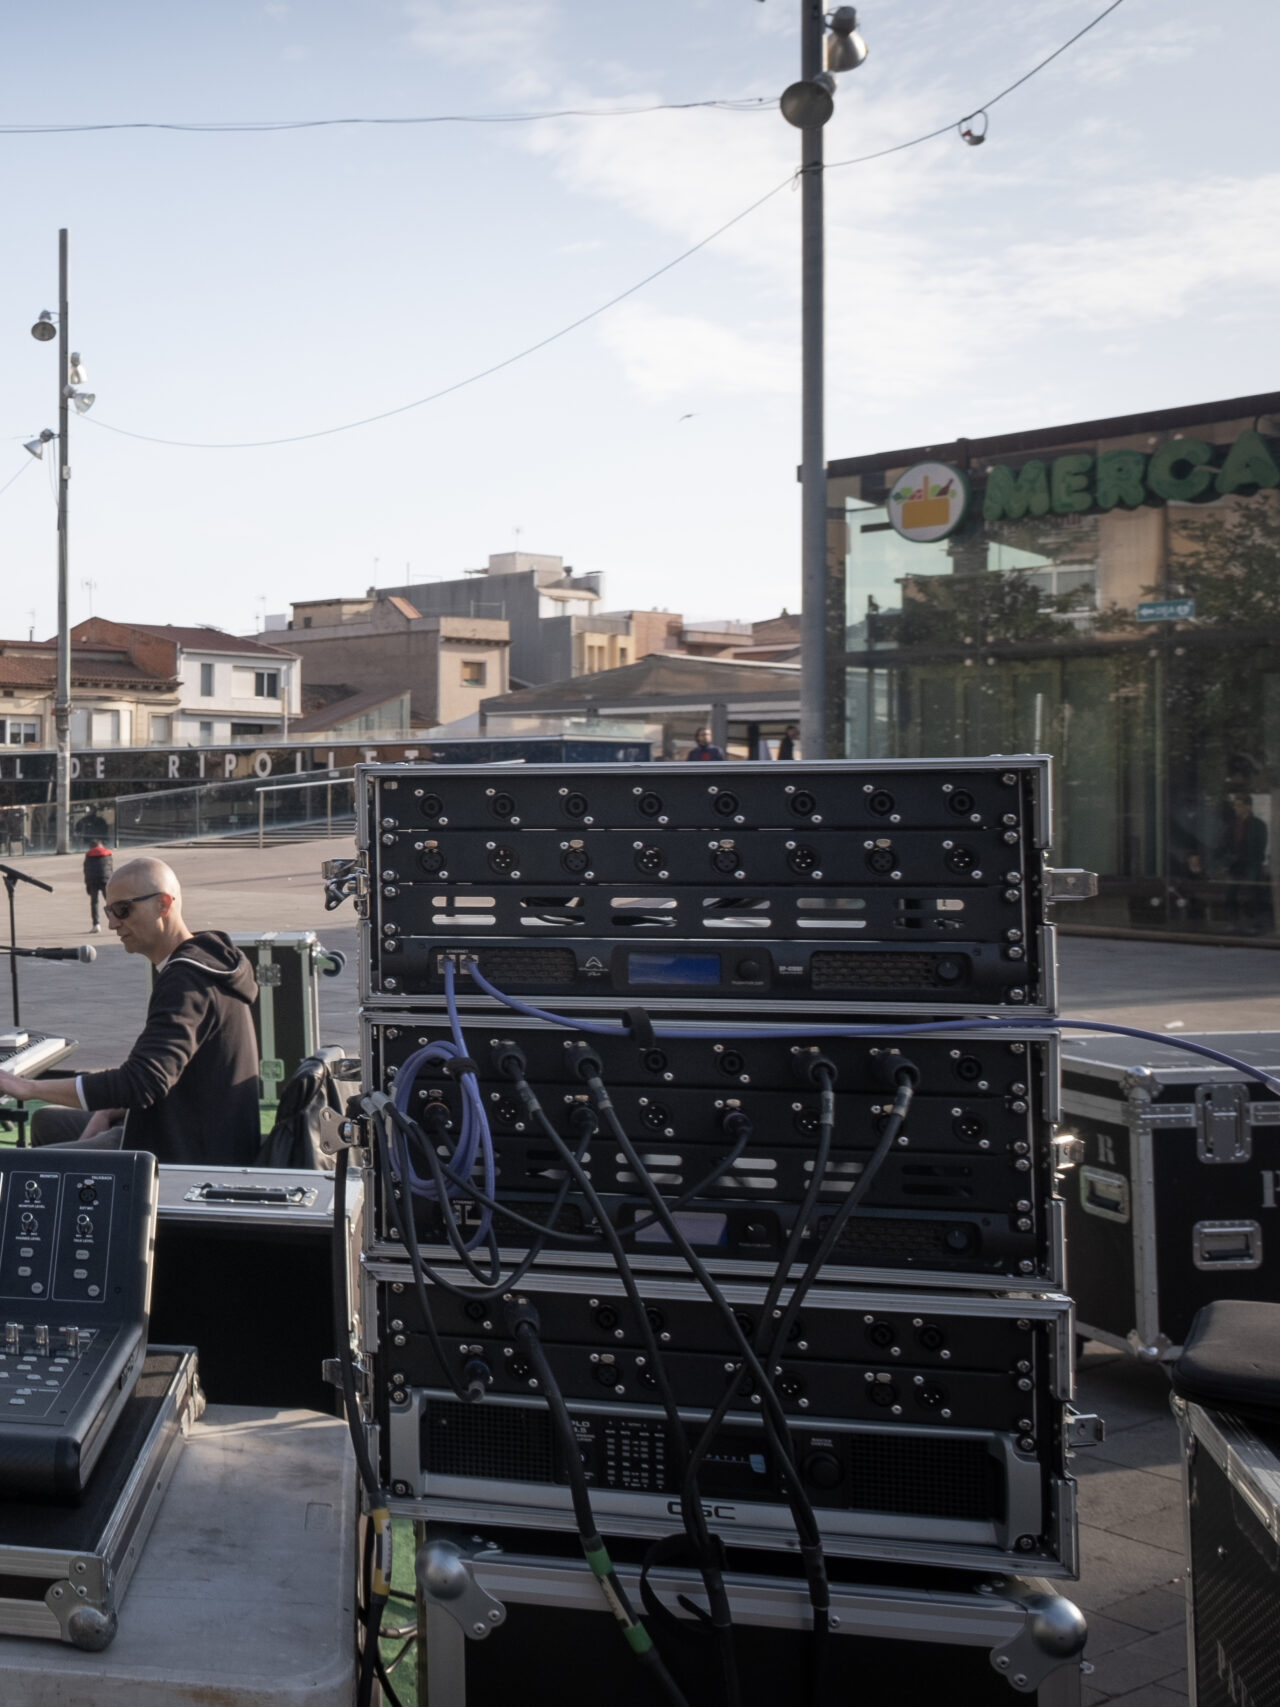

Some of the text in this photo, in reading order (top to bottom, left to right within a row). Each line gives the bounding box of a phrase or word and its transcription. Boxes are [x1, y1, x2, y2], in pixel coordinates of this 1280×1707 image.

[983, 428, 1280, 521] MERCA
[70, 757, 105, 779] DE
[1097, 1133, 1116, 1165] R
